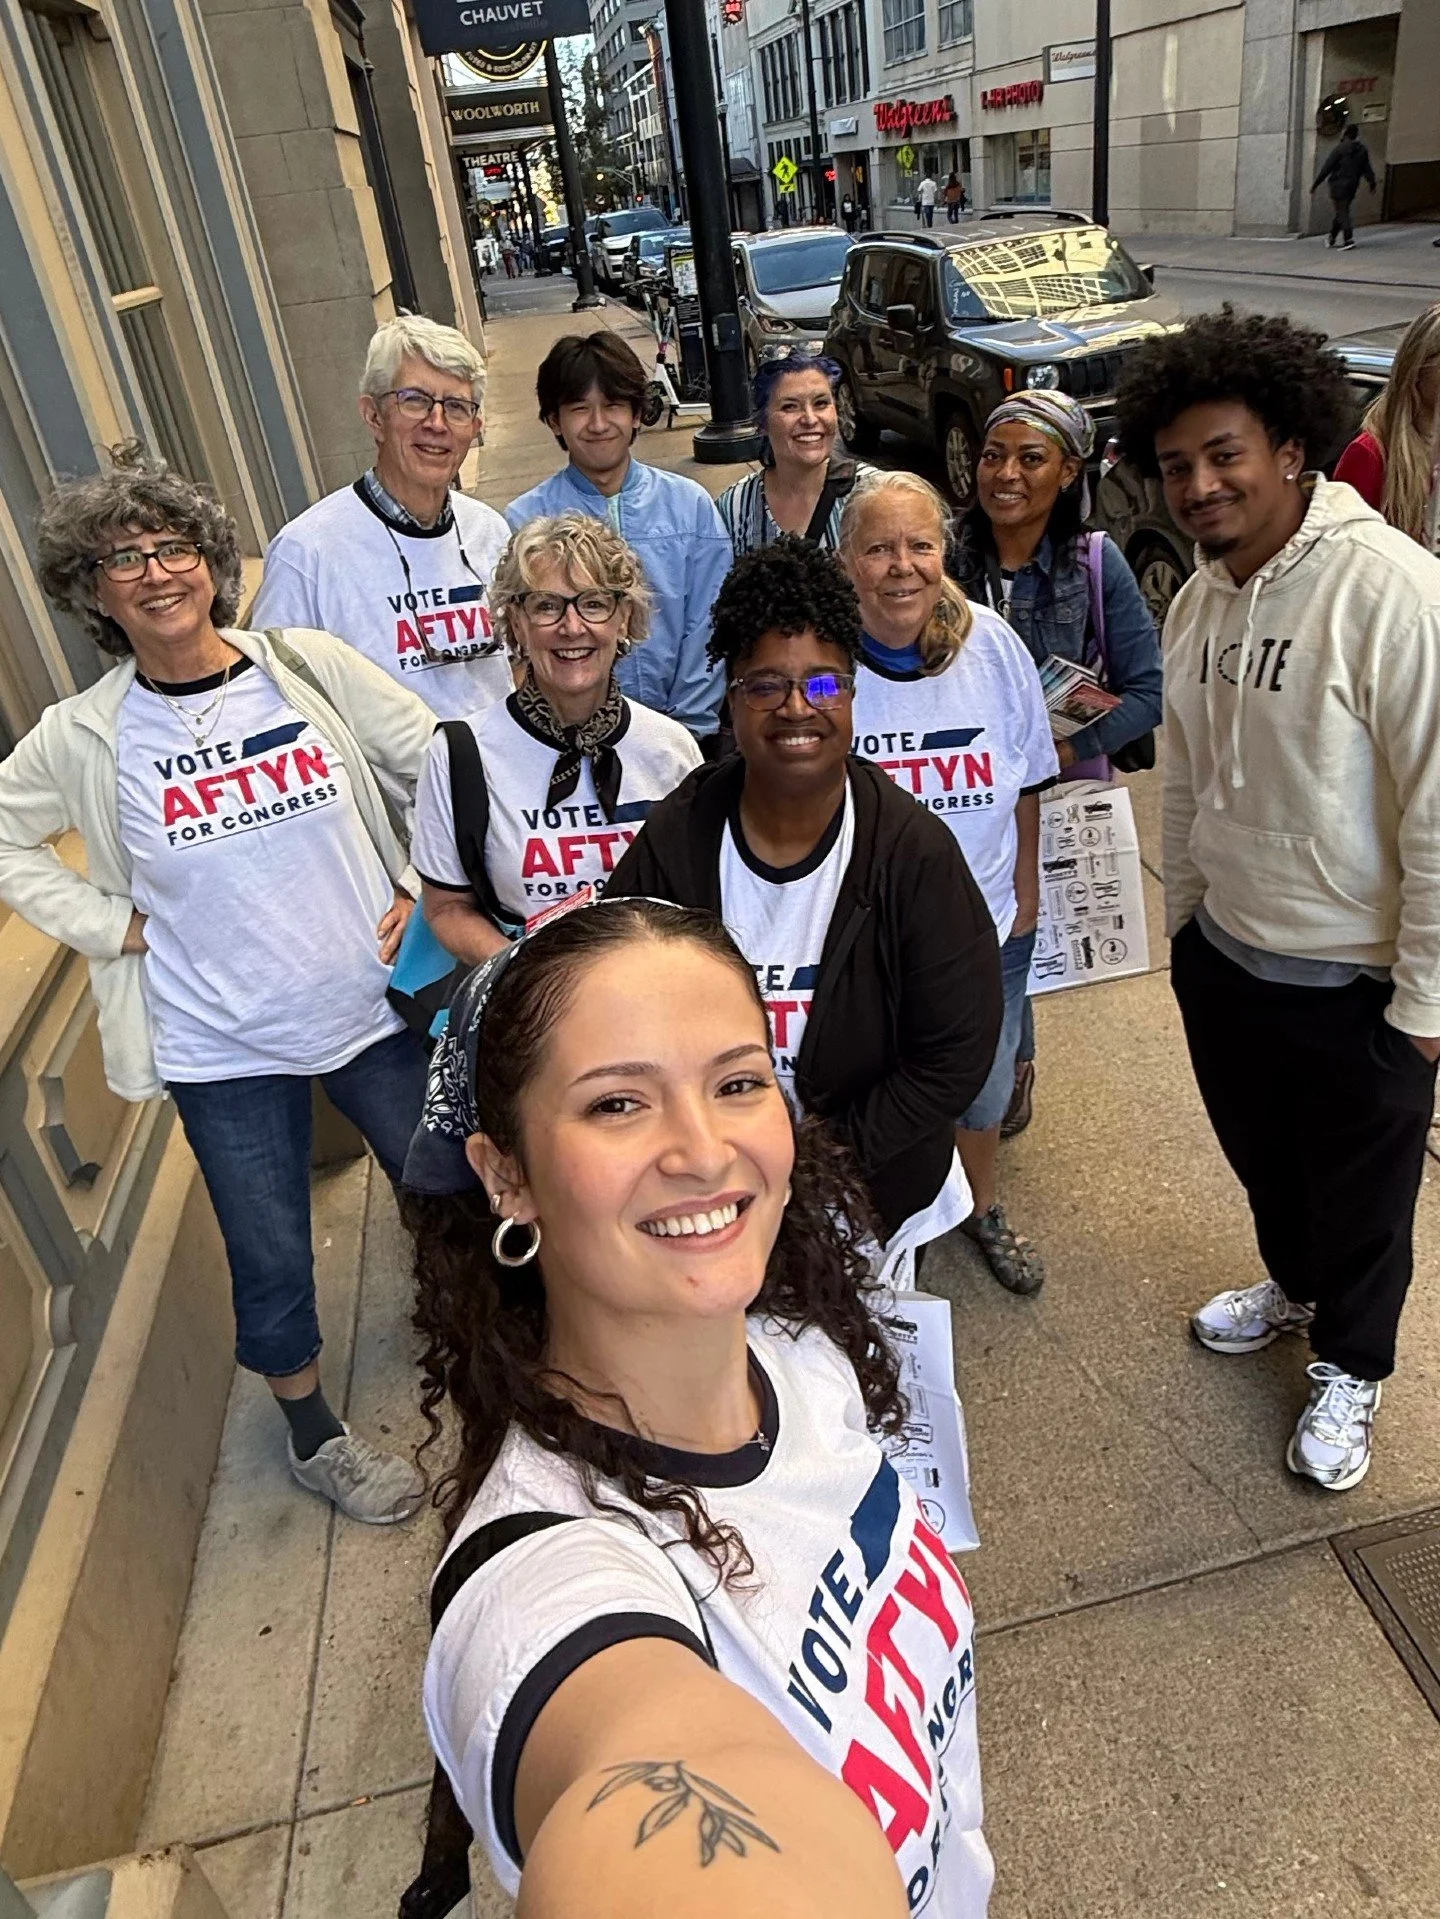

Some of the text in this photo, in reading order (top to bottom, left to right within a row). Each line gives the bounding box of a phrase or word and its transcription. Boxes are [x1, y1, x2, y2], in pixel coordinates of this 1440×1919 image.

[460, 1, 543, 26] CHAUVET
[1006, 80, 1043, 106] PHOTO
[451, 101, 540, 121] WOOLWORTH
[462, 151, 520, 167] THEATRE
[387, 588, 446, 614] VOTE
[153, 741, 237, 780] VOTE
[164, 745, 330, 827] AFTYN
[167, 783, 338, 846] FOR CONGRESS
[521, 804, 603, 830] VOTE
[524, 882, 568, 897] FOR
[787, 1548, 864, 1735] VOTE
